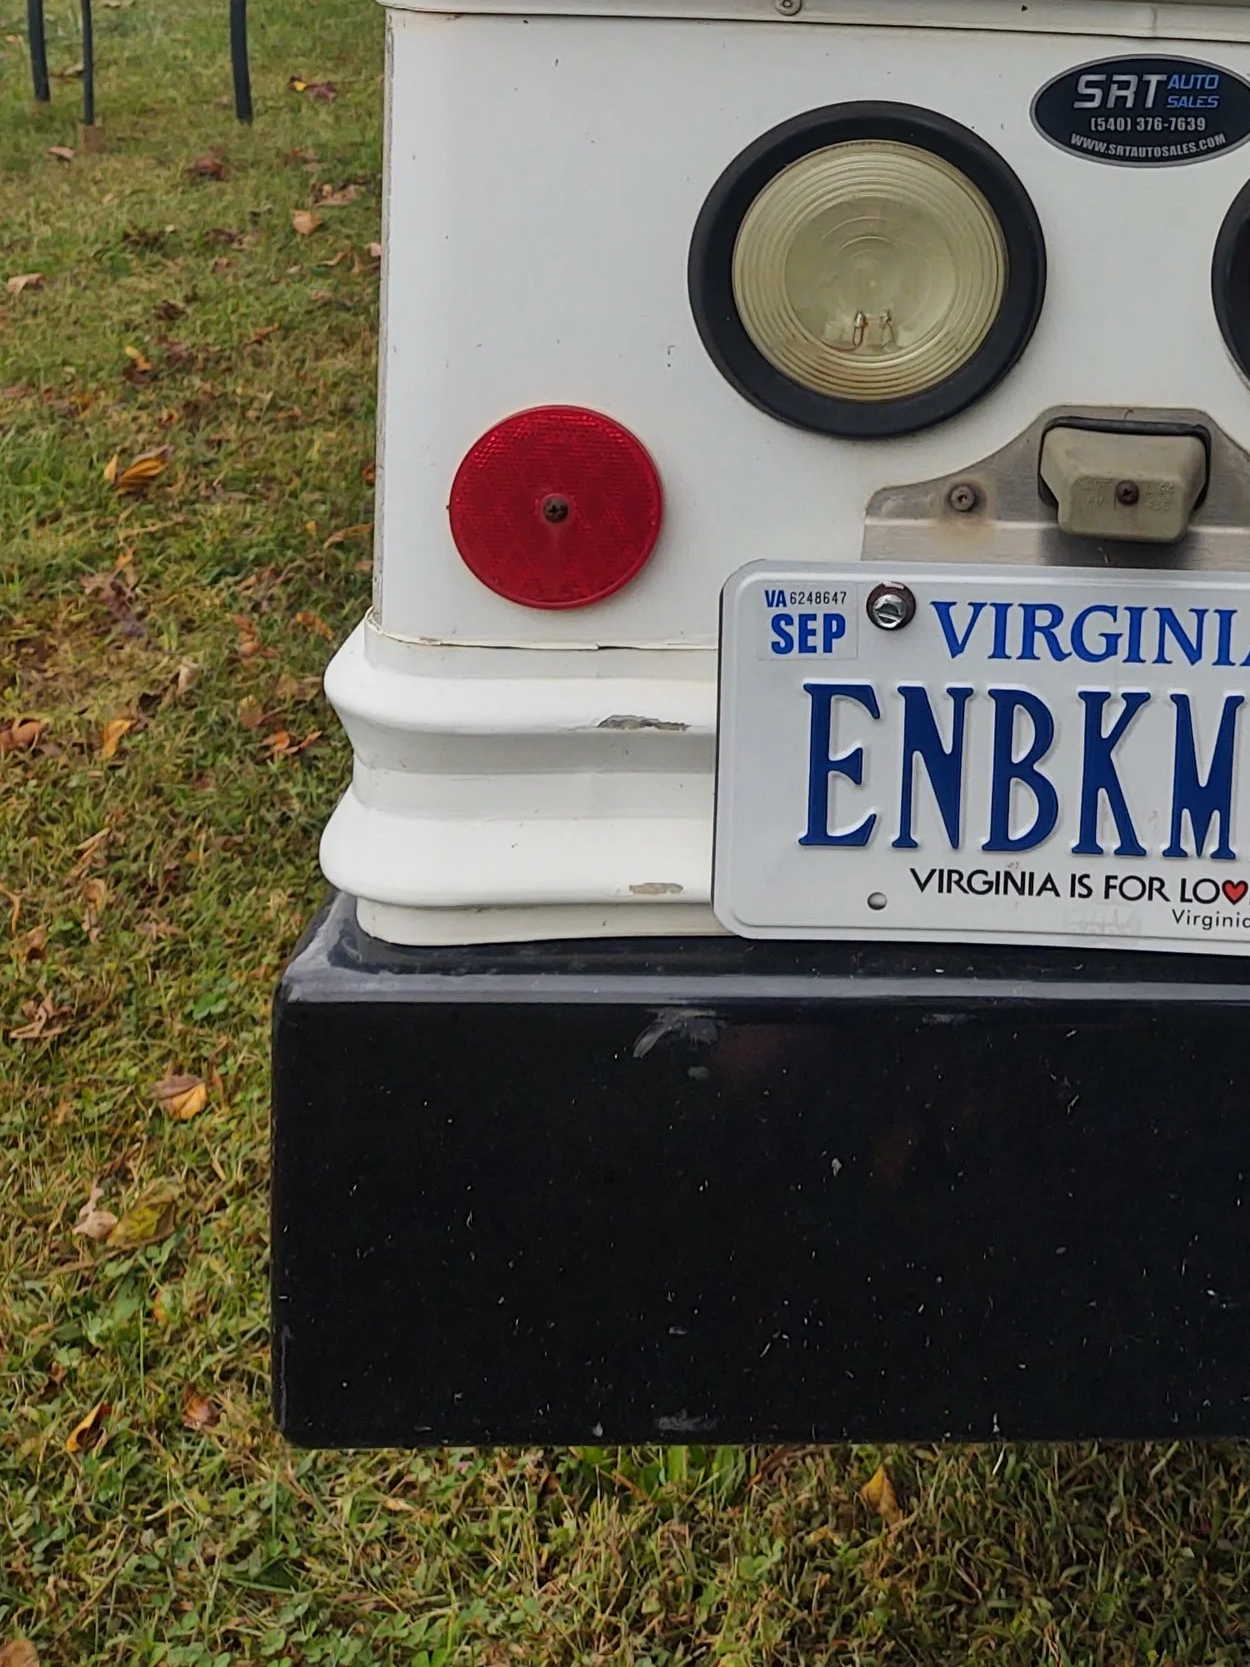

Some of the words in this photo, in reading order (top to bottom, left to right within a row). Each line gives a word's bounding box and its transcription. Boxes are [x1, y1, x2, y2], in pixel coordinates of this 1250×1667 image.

[1073, 73, 1168, 110] SRT
[1167, 74, 1220, 90] AUTO
[1166, 95, 1220, 109] SALES
[1090, 117, 1132, 132] (540)
[1136, 117, 1206, 132] 376-7639
[1070, 133, 1227, 158] WWW.SRTAUTOSALES.COM
[764, 590, 787, 608] VA
[789, 590, 847, 605] 6248647
[771, 613, 846, 655] SEP
[909, 867, 1061, 898] VIRGINIA
[1069, 873, 1093, 899] IS
[1103, 874, 1171, 902] FOR
